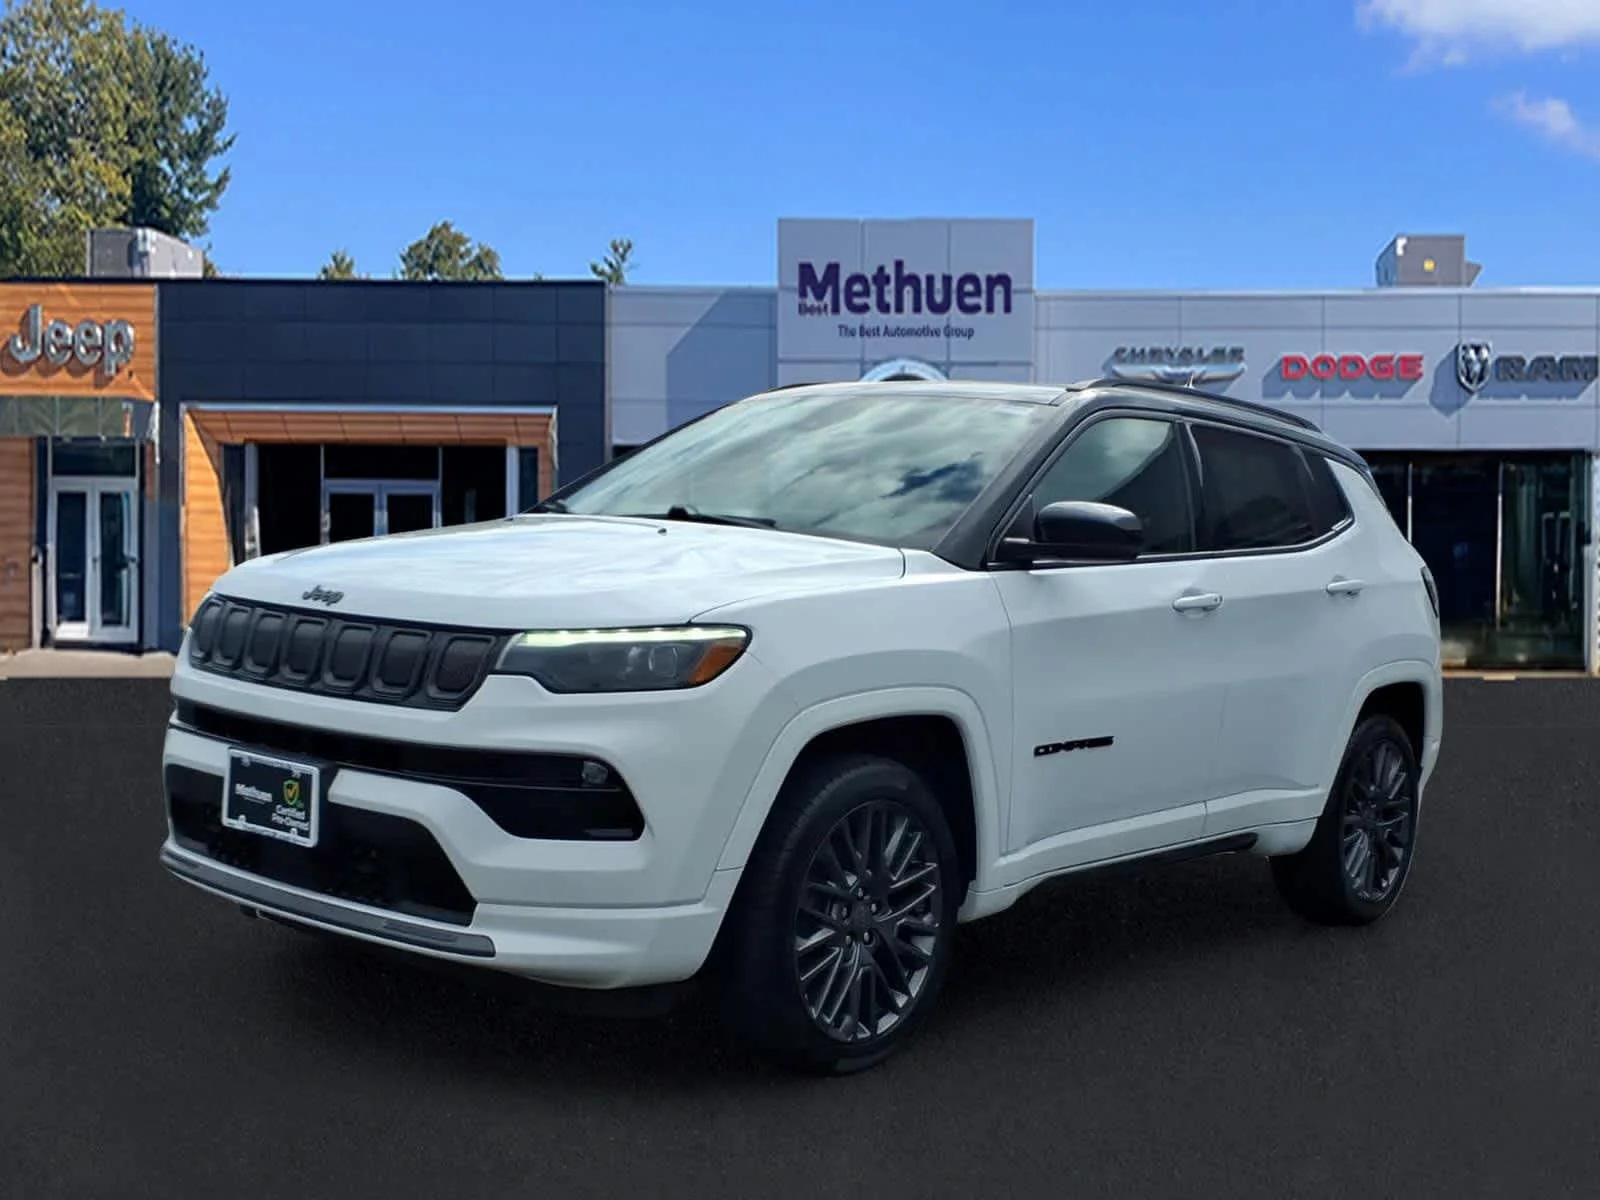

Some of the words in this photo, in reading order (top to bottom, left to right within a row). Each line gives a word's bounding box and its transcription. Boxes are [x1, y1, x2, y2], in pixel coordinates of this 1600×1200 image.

[798, 260, 1012, 315] Methuen
[798, 303, 828, 316] Best
[9, 304, 135, 376] Jeep
[838, 324, 857, 337] The
[859, 324, 880, 337] Best
[883, 324, 941, 337] Automotive
[943, 324, 974, 340] Group
[1113, 346, 1245, 363] CHRYSLER
[1281, 354, 1424, 380] DODGE
[1495, 355, 1599, 382] RAM
[302, 585, 344, 606] Jeep
